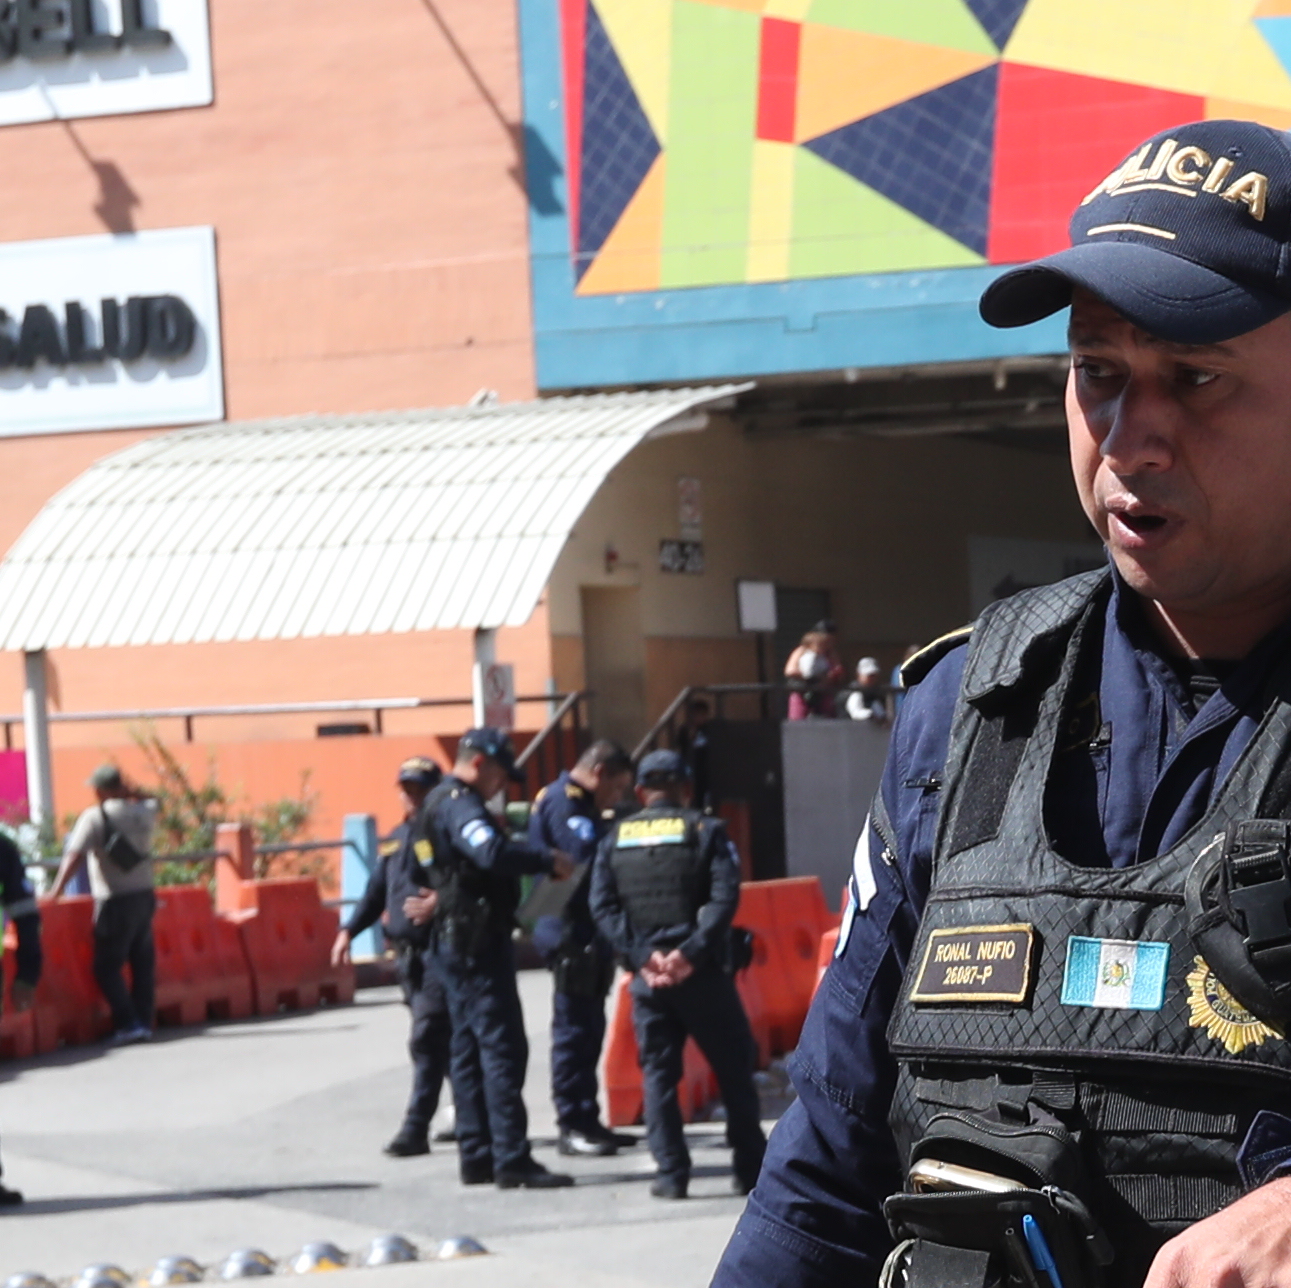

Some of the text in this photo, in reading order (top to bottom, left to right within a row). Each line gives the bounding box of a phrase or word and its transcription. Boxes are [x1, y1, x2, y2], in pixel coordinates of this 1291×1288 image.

[0, 0, 172, 62] ELL
[1081, 138, 1268, 221] LICIA
[934, 940, 1016, 963] RONAL NUFIO
